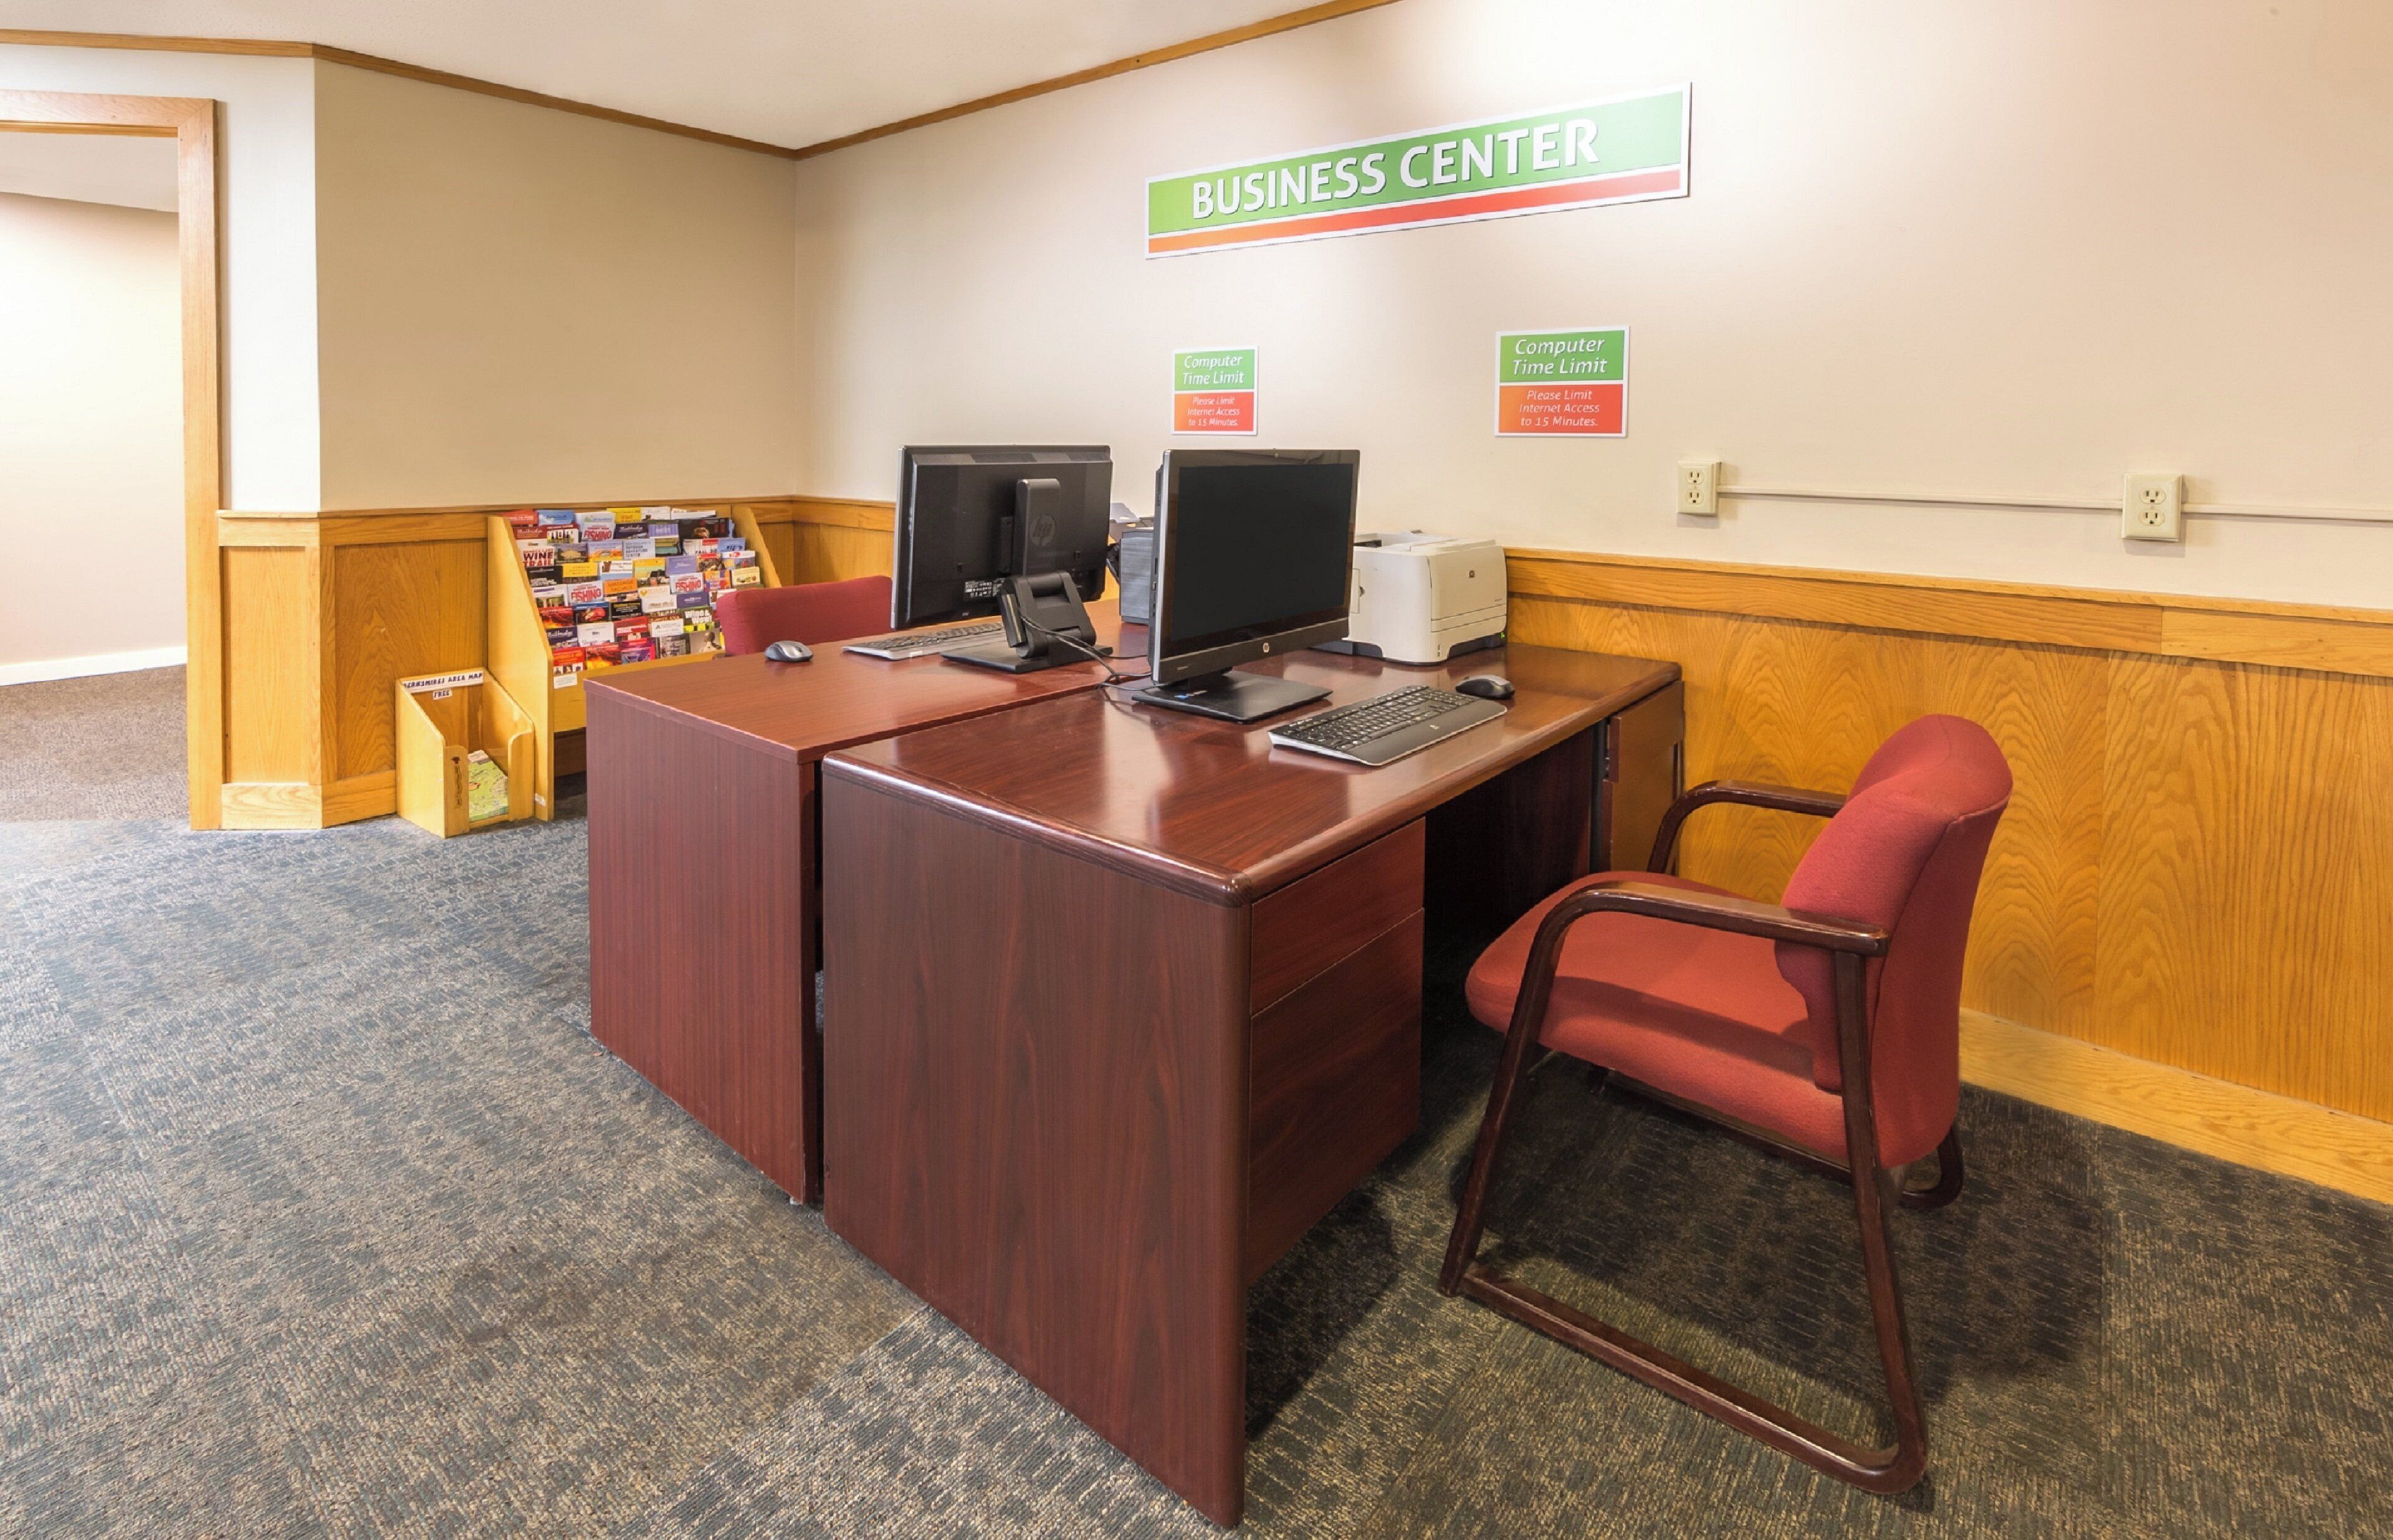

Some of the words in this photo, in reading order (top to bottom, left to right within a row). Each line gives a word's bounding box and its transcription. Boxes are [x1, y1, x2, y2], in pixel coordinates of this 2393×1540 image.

[1193, 153, 1387, 219] BUSINESS
[1400, 118, 1600, 188] CENTER
[1515, 338, 1605, 358] Computer
[1183, 355, 1243, 371] Computer
[1512, 359, 1554, 375] Time
[1559, 357, 1608, 374] Limit
[1183, 373, 1210, 384] Time
[1213, 371, 1244, 384] Limit
[1527, 390, 1561, 400] Please
[1564, 390, 1592, 400] Limit
[1193, 397, 1215, 405] Please
[1216, 397, 1235, 405] Limit
[1216, 407, 1240, 416] Access
[1519, 403, 1560, 412] Internet
[1563, 403, 1600, 412] Access
[1198, 419, 1207, 427] 15
[1521, 417, 1532, 426] to
[1535, 417, 1549, 427] 15
[1552, 416, 1598, 426] Minutes.
[583, 530, 612, 541] FISHING
[523, 551, 553, 561] WINE
[676, 579, 702, 592] FISHING
[571, 588, 602, 602] FISHING
[434, 690, 450, 698] FREE
